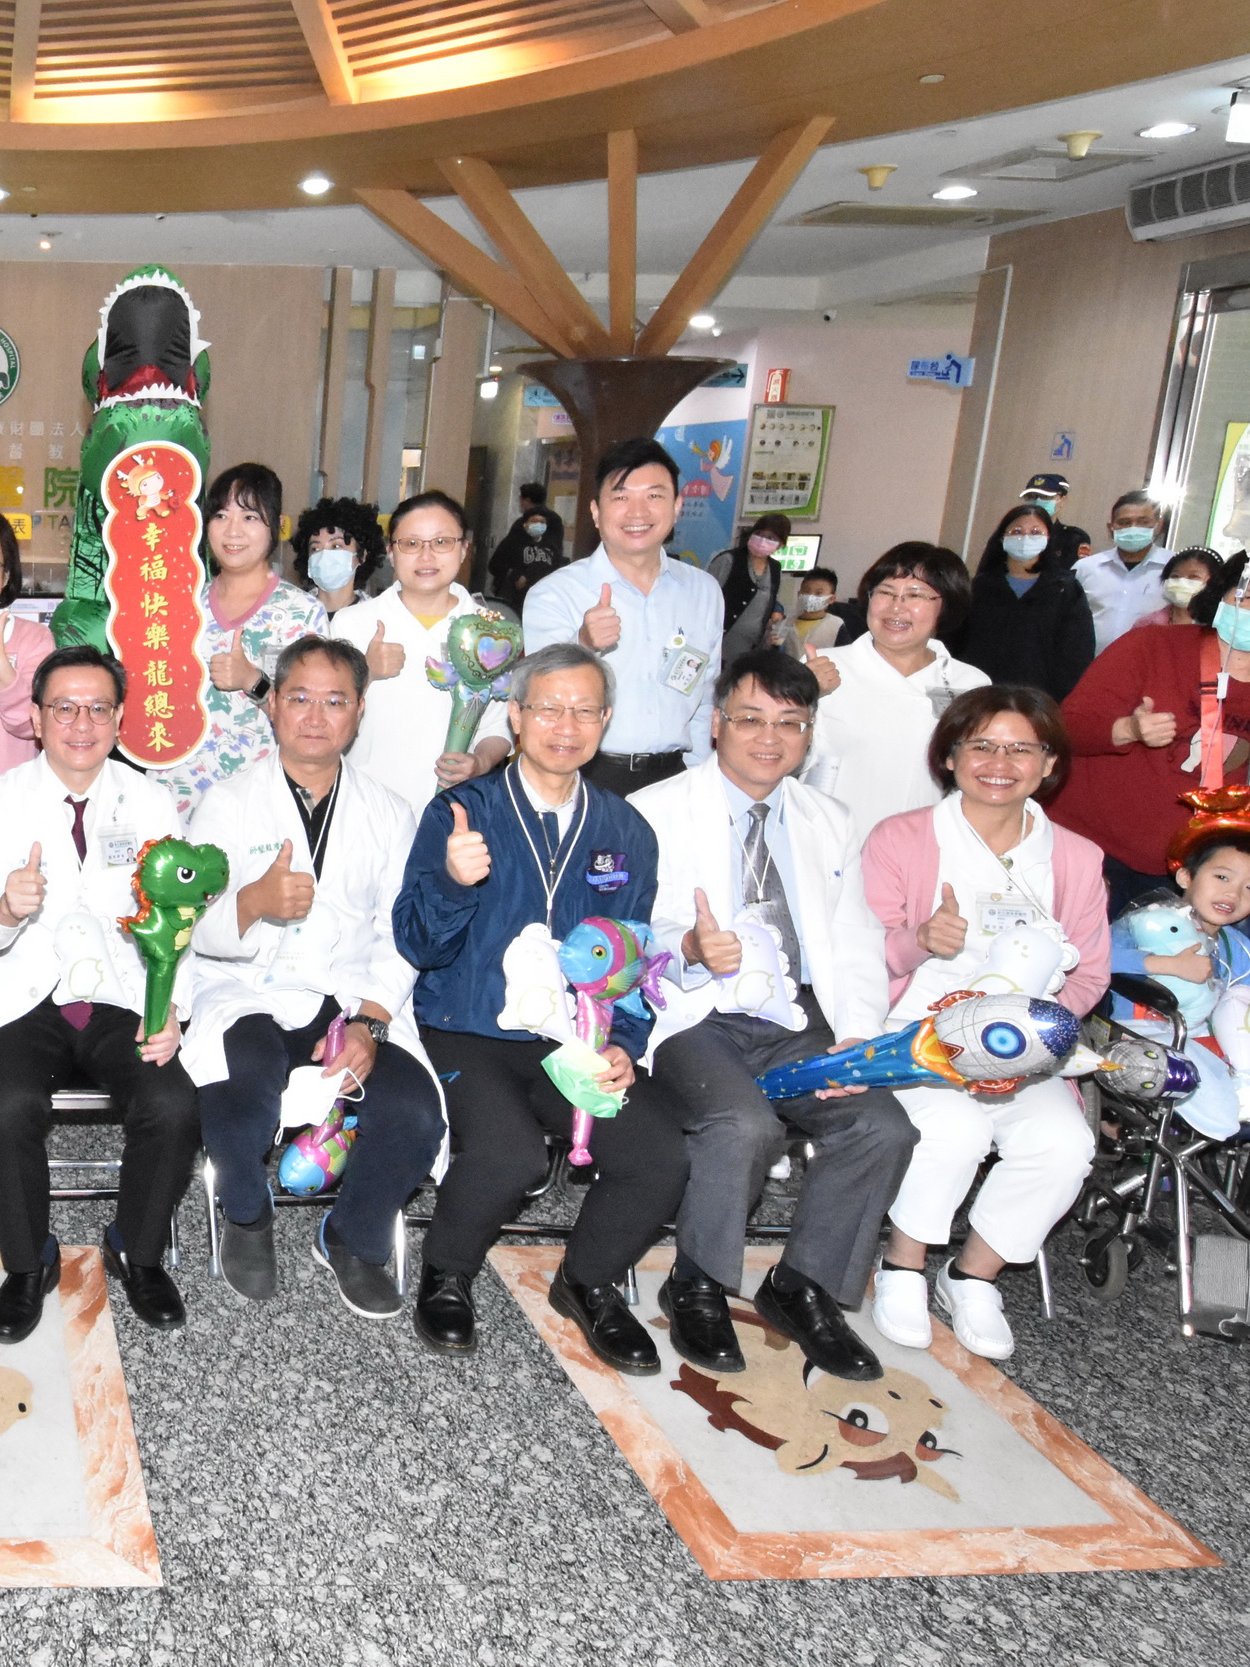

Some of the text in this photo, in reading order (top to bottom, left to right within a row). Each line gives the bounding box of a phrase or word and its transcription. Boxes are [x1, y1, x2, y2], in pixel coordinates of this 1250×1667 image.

[0, 337, 16, 369] HOSPITAL
[139, 522, 176, 752] 幸福快樂龍總來
